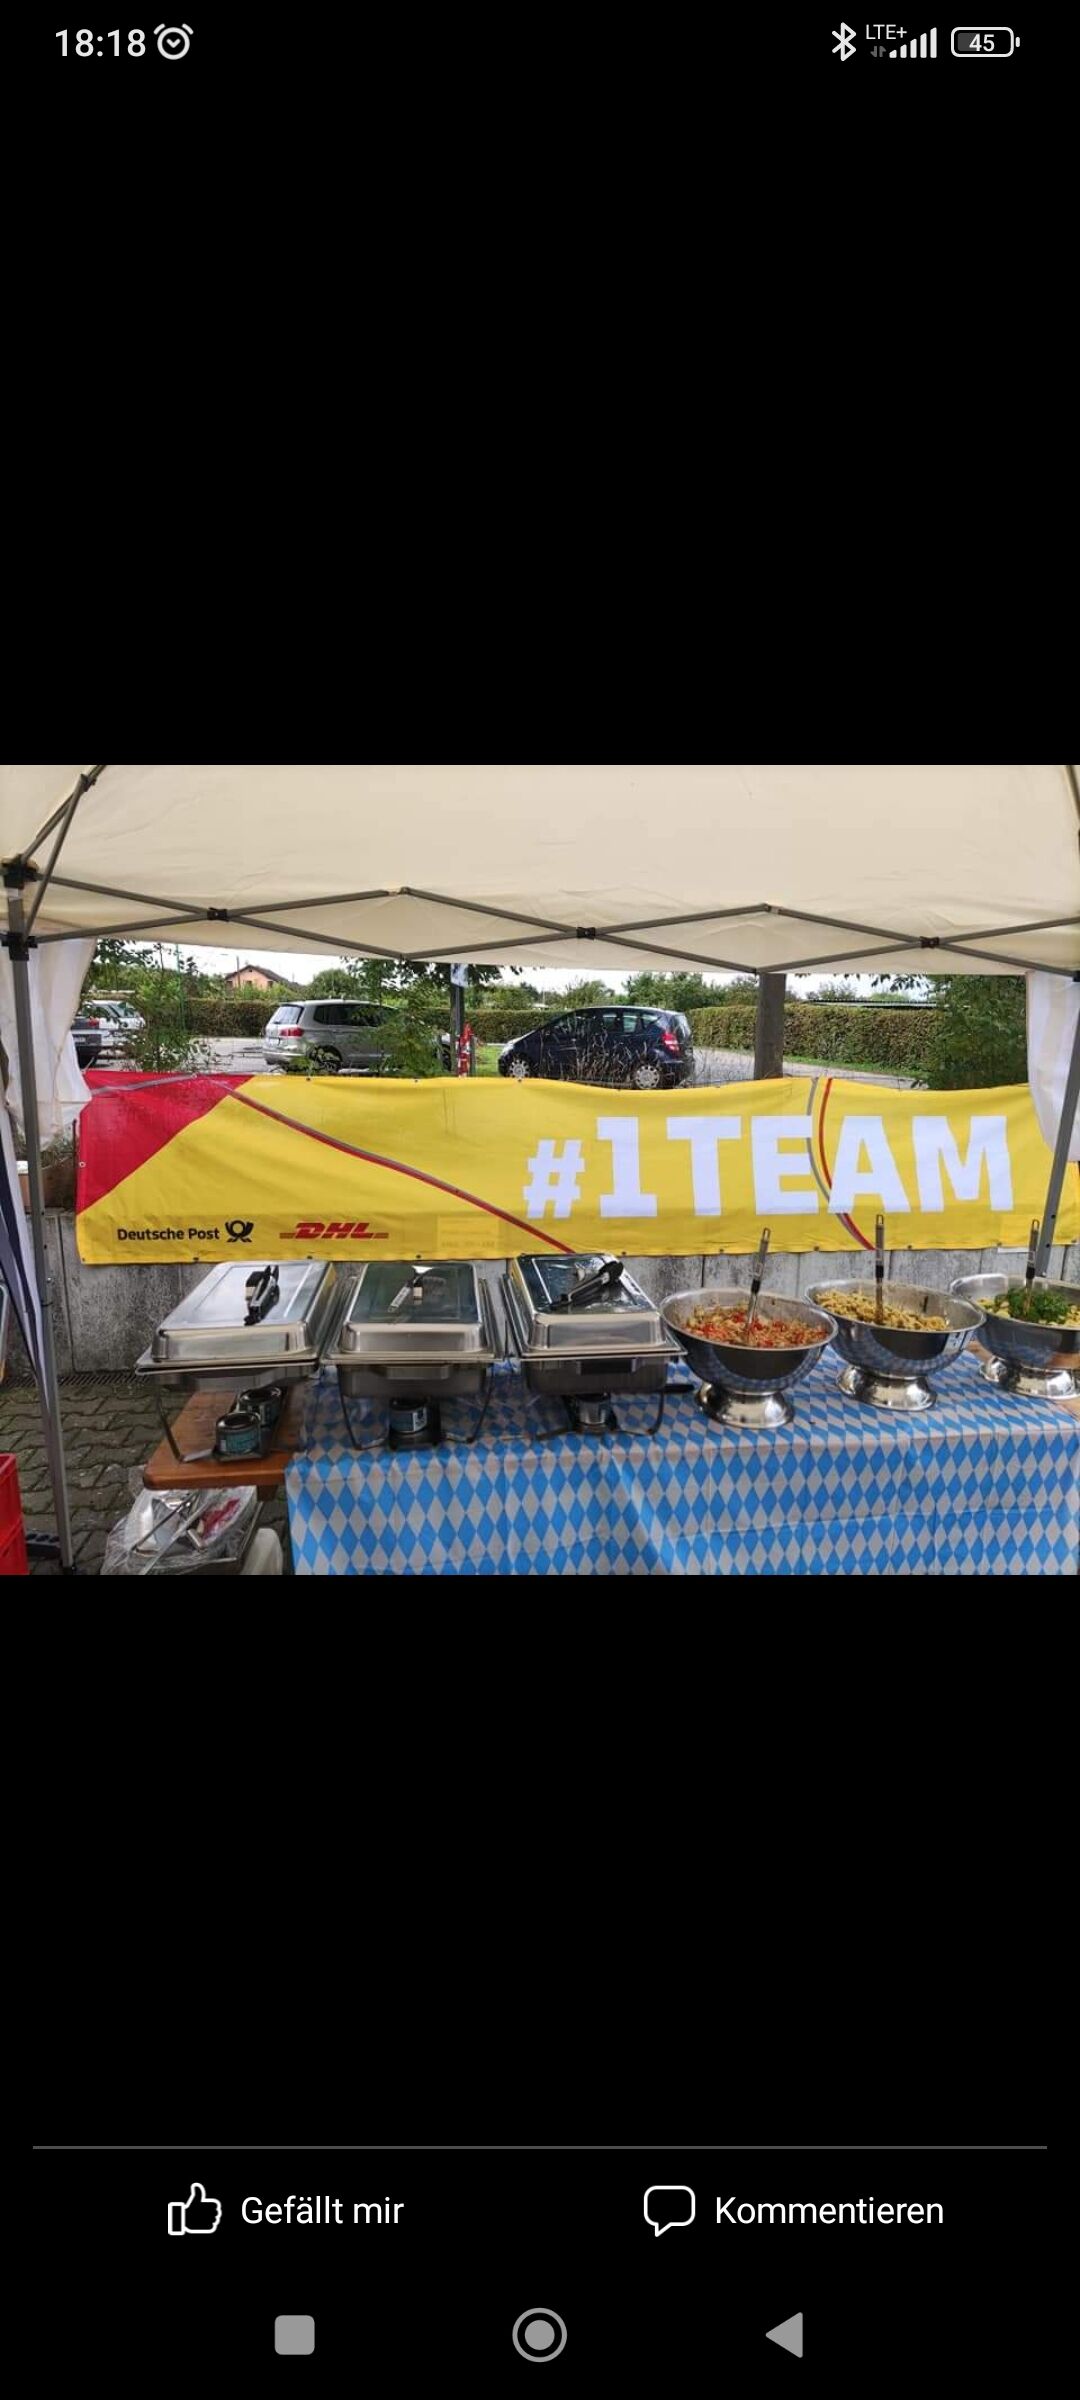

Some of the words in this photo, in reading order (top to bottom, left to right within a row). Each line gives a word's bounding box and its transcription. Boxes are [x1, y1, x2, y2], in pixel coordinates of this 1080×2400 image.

[523, 1115, 1014, 1218] #1TEAM
[117, 1227, 185, 1241] Deutsche
[188, 1227, 220, 1240] Post
[294, 1222, 374, 1240] DHL
